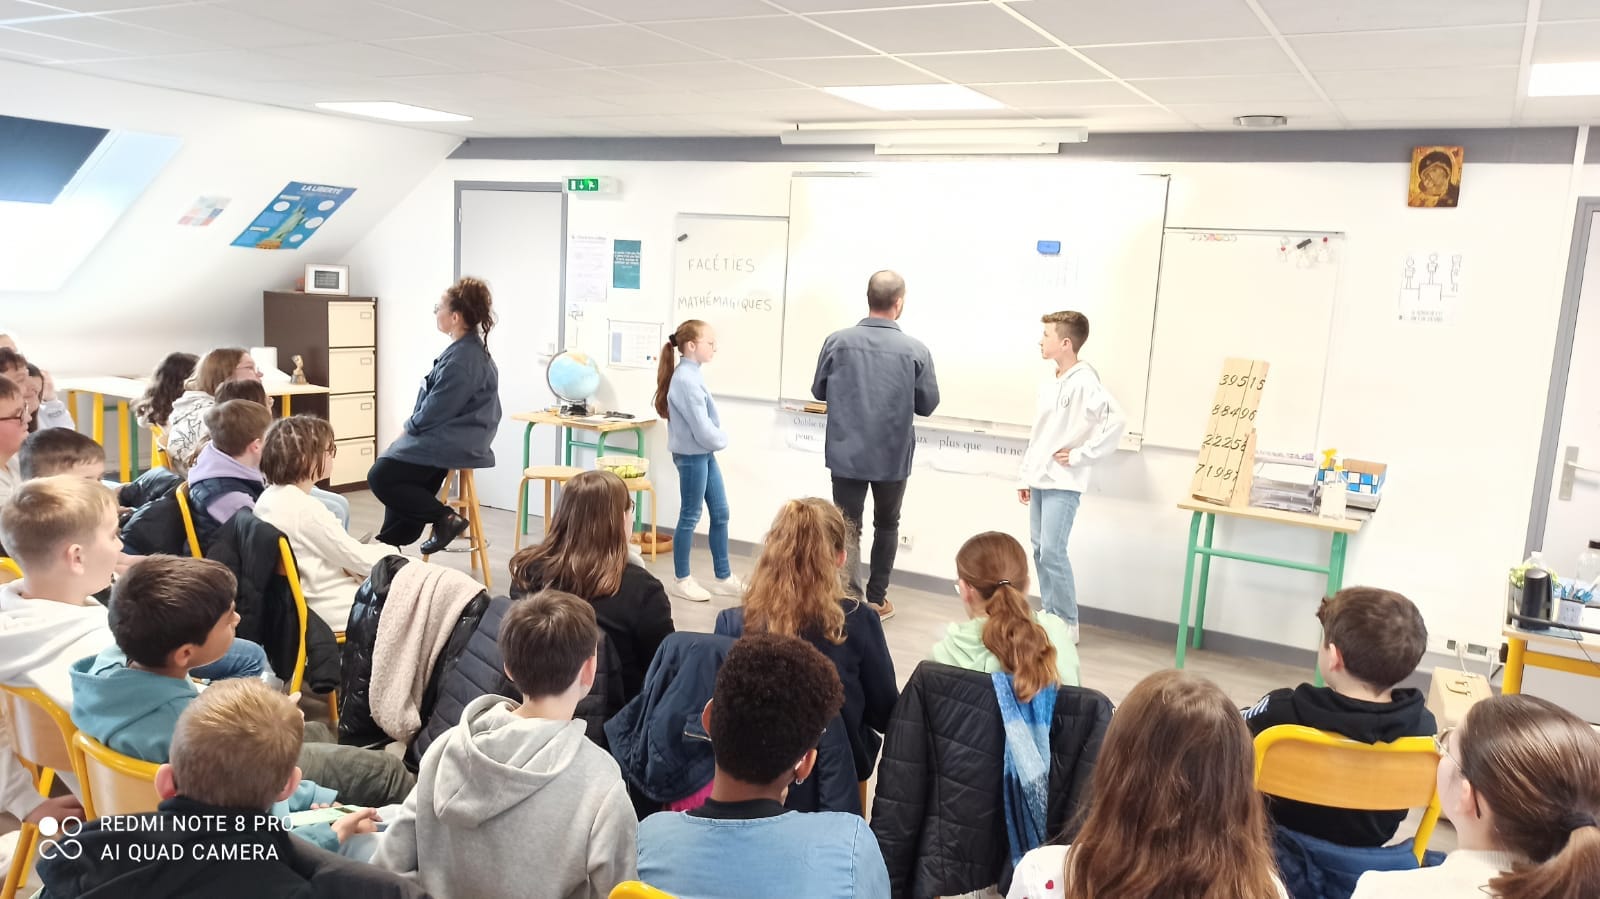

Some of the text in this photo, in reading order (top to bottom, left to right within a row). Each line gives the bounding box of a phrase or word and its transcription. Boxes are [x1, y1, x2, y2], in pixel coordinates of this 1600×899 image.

[301, 184, 313, 192] LA
[688, 253, 756, 272] FACÉTIES
[677, 290, 772, 312] MATHÉMAGIQUES
[1219, 374, 1266, 390] 39515
[1211, 403, 1257, 421] 88496
[939, 435, 961, 450] plus
[963, 441, 982, 453] que
[995, 446, 1007, 455] tu
[1010, 447, 1023, 456] ne
